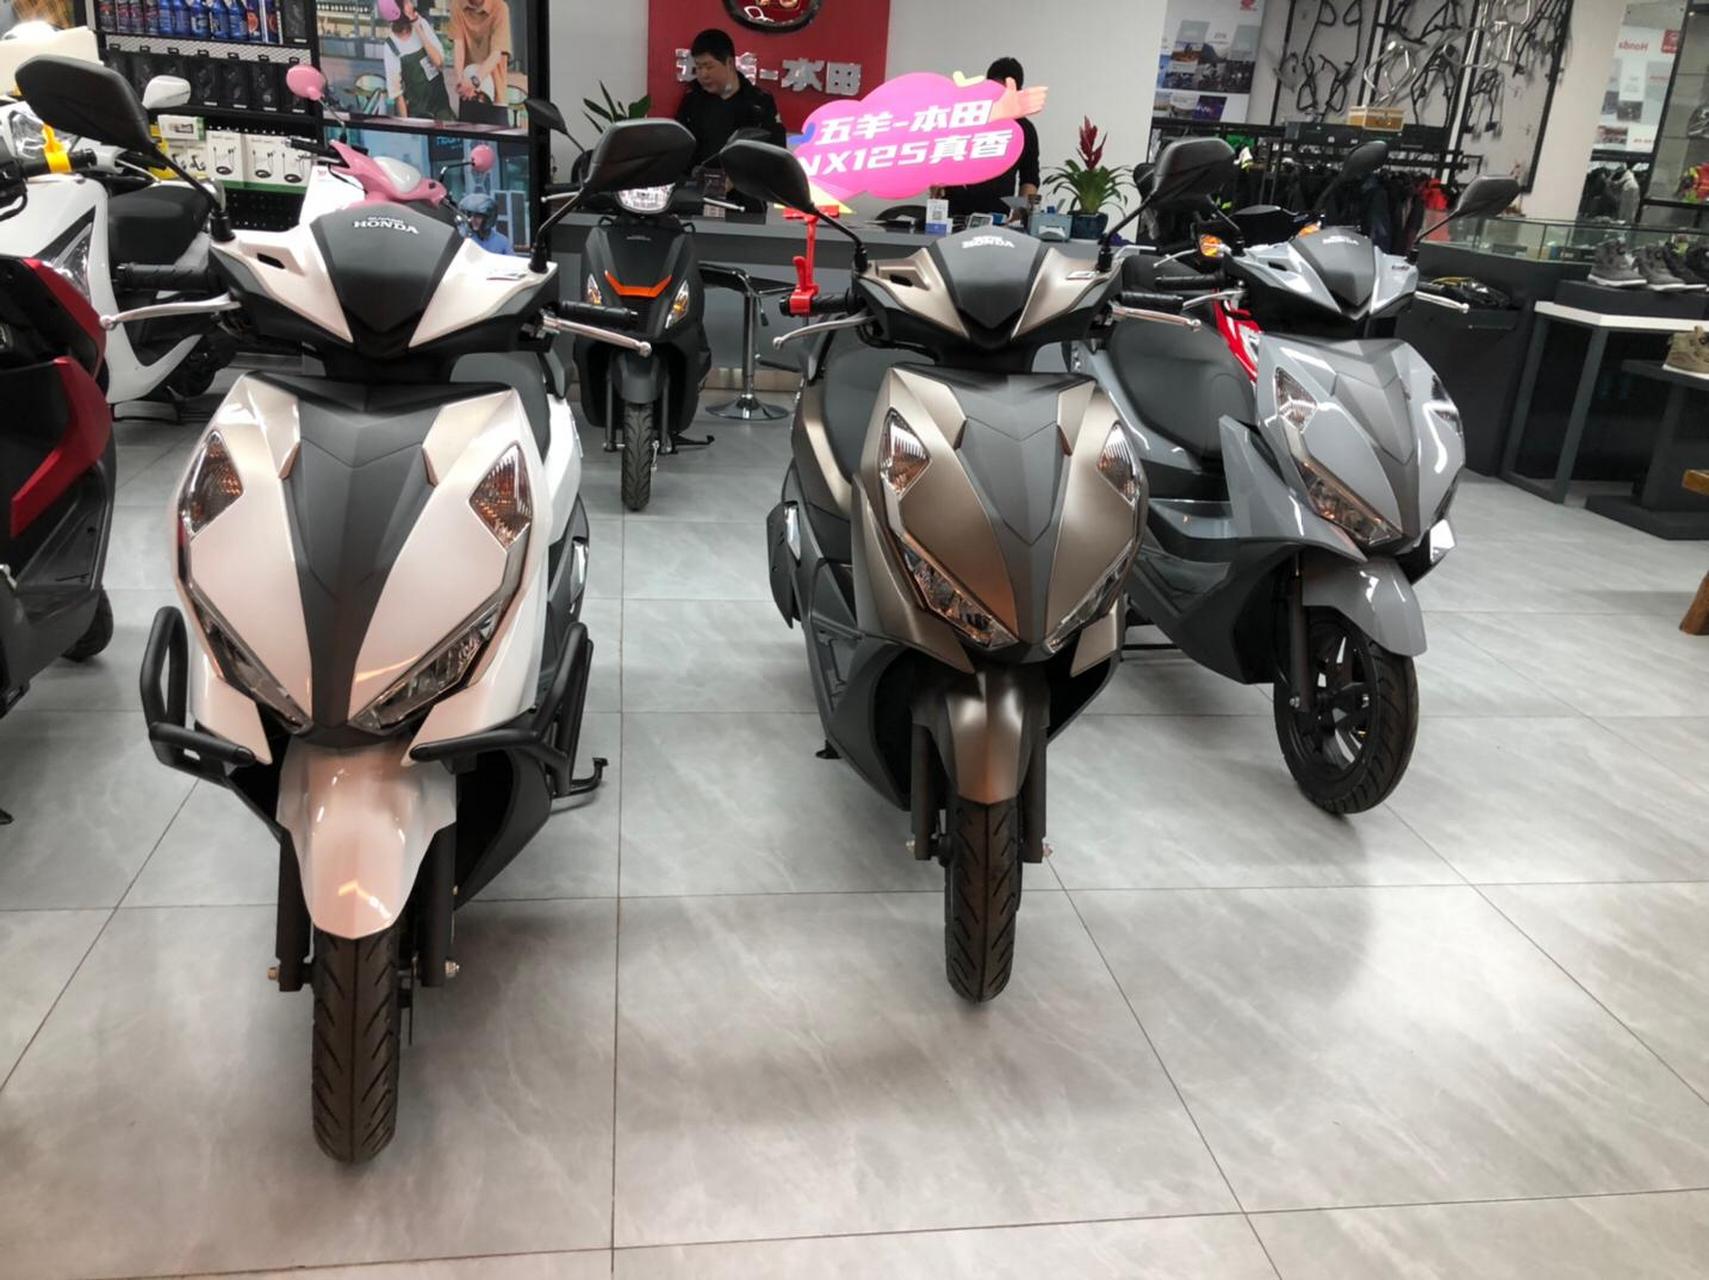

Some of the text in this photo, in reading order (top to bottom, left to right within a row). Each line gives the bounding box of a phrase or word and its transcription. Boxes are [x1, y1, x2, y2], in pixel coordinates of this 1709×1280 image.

[815, 99, 993, 145] 五羊-本田
[798, 129, 1013, 176] NX125真香
[353, 220, 419, 234] HONDA
